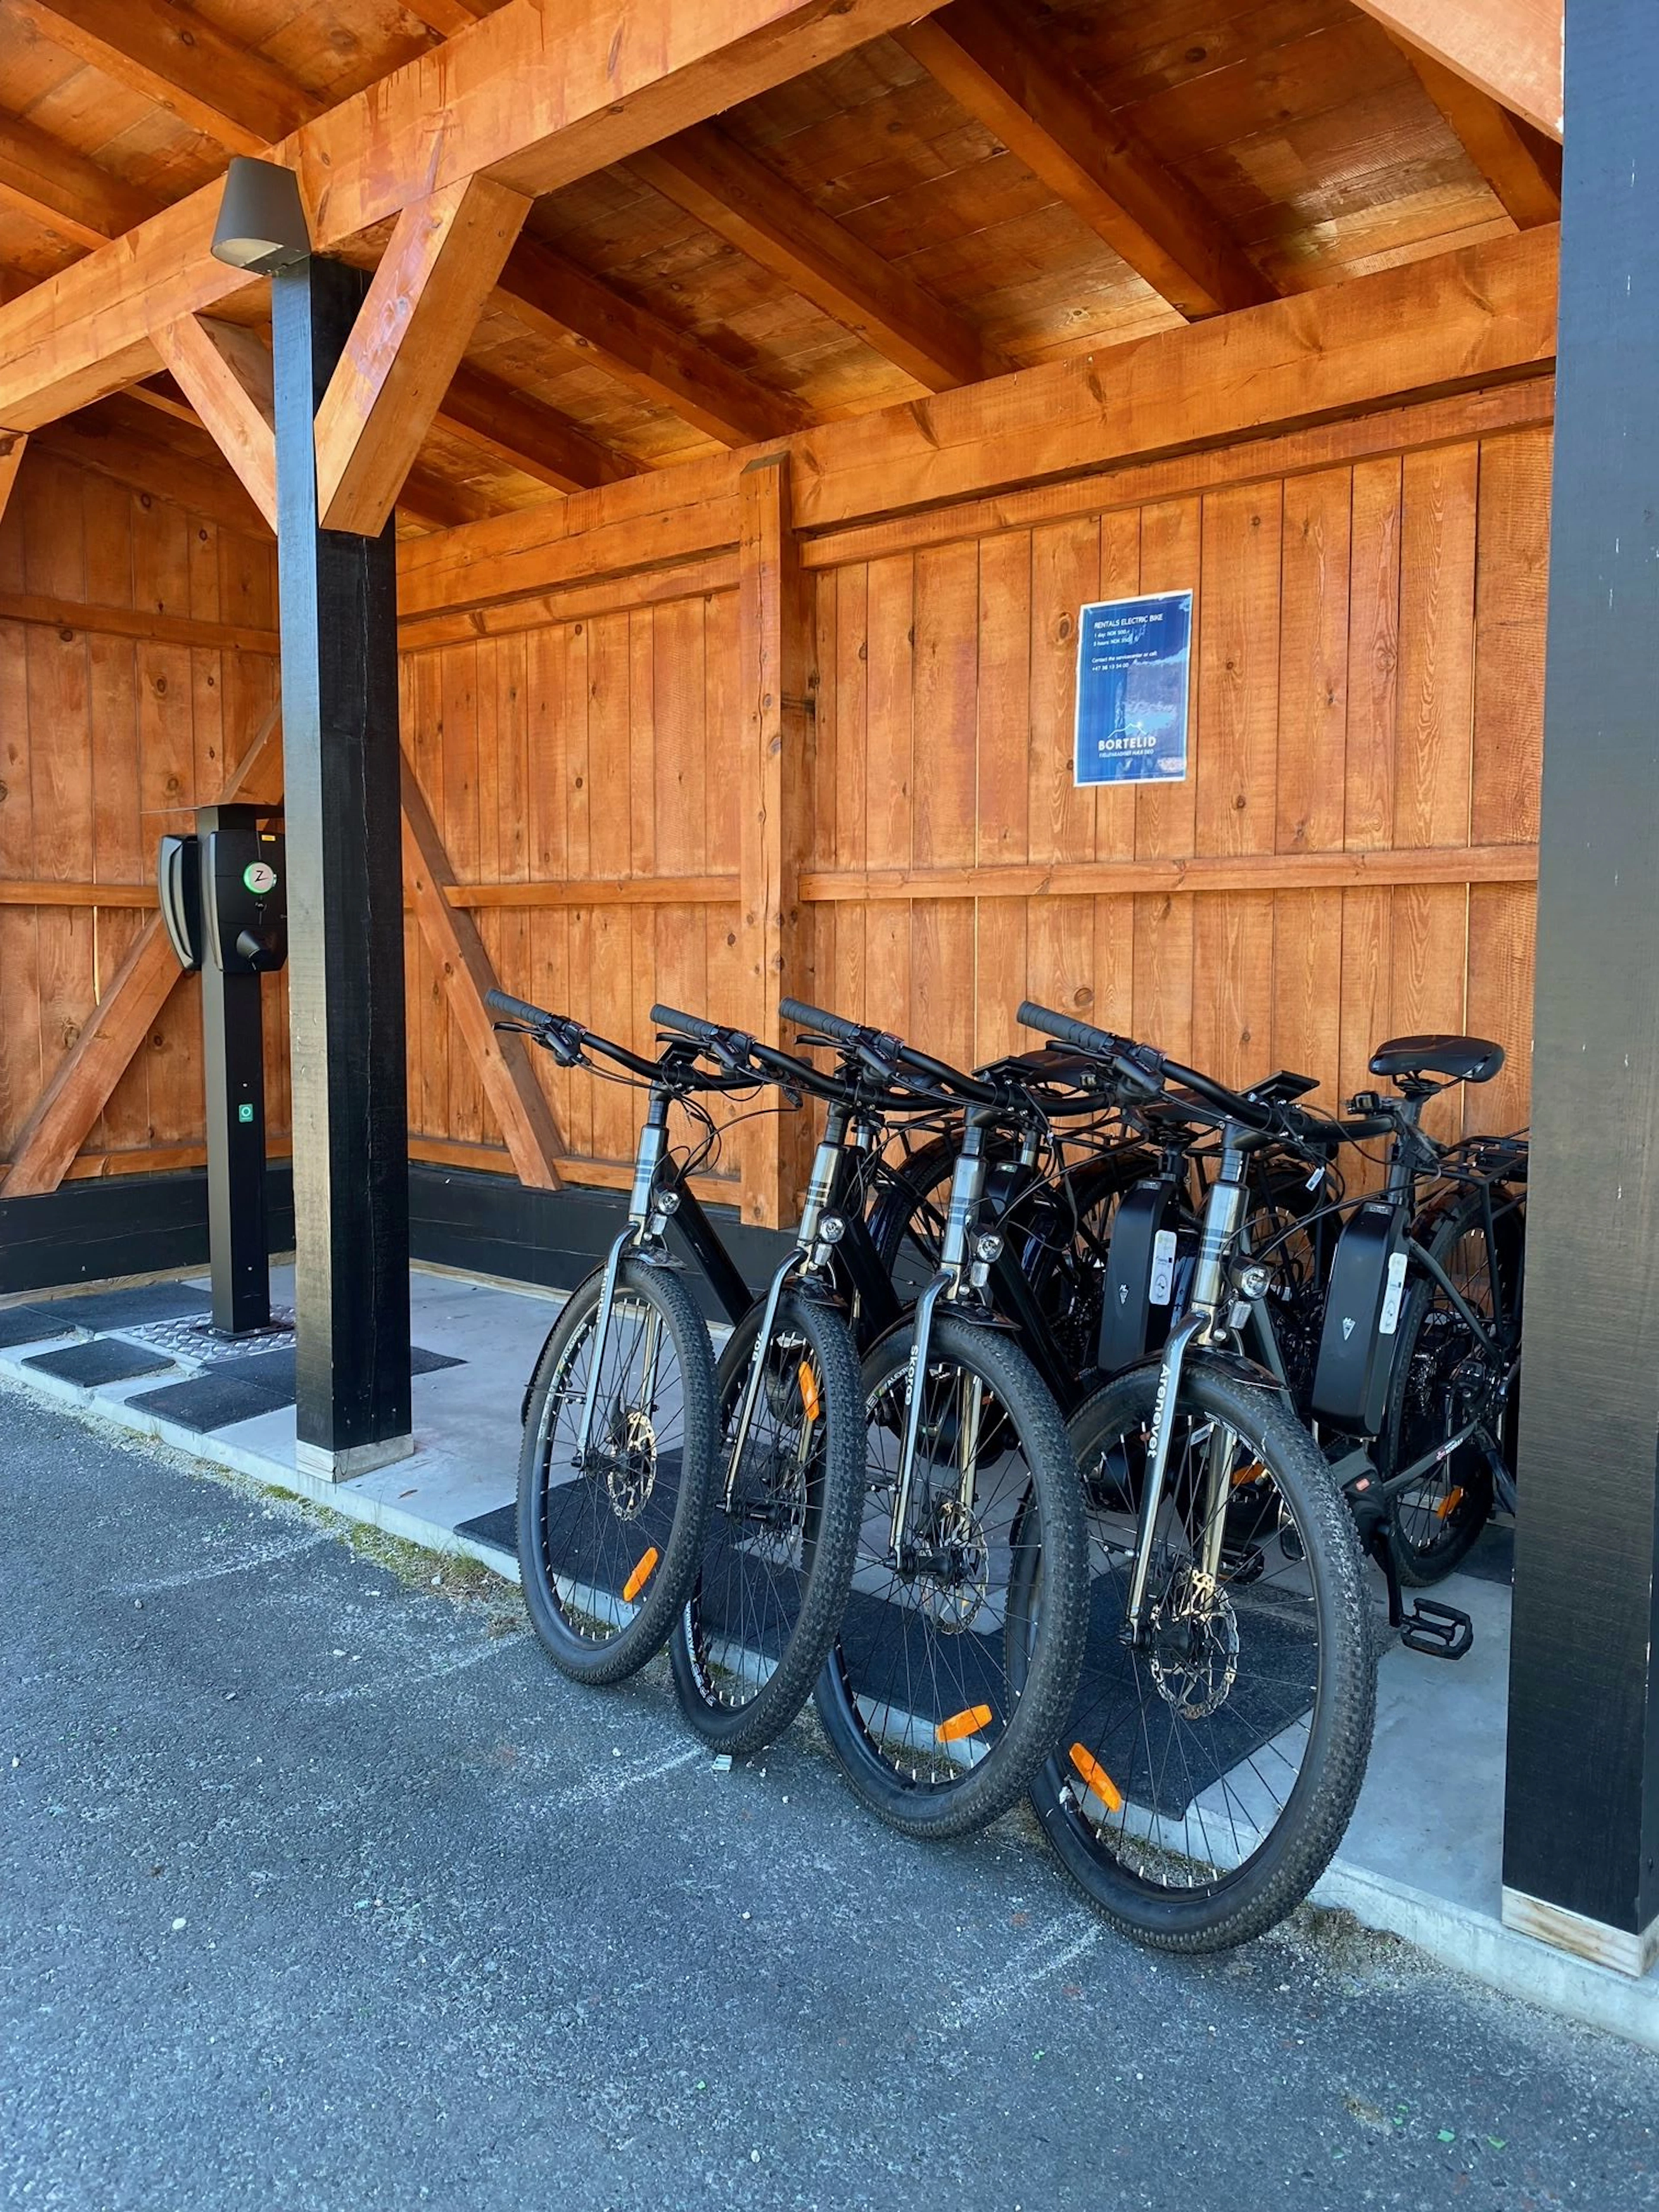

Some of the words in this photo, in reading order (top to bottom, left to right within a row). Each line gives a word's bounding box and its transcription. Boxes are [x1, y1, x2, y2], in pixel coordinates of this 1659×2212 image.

[1094, 620, 1119, 629] RENTALS
[1121, 615, 1148, 626] ELECTRIC
[1098, 736, 1156, 751] BORTELID
